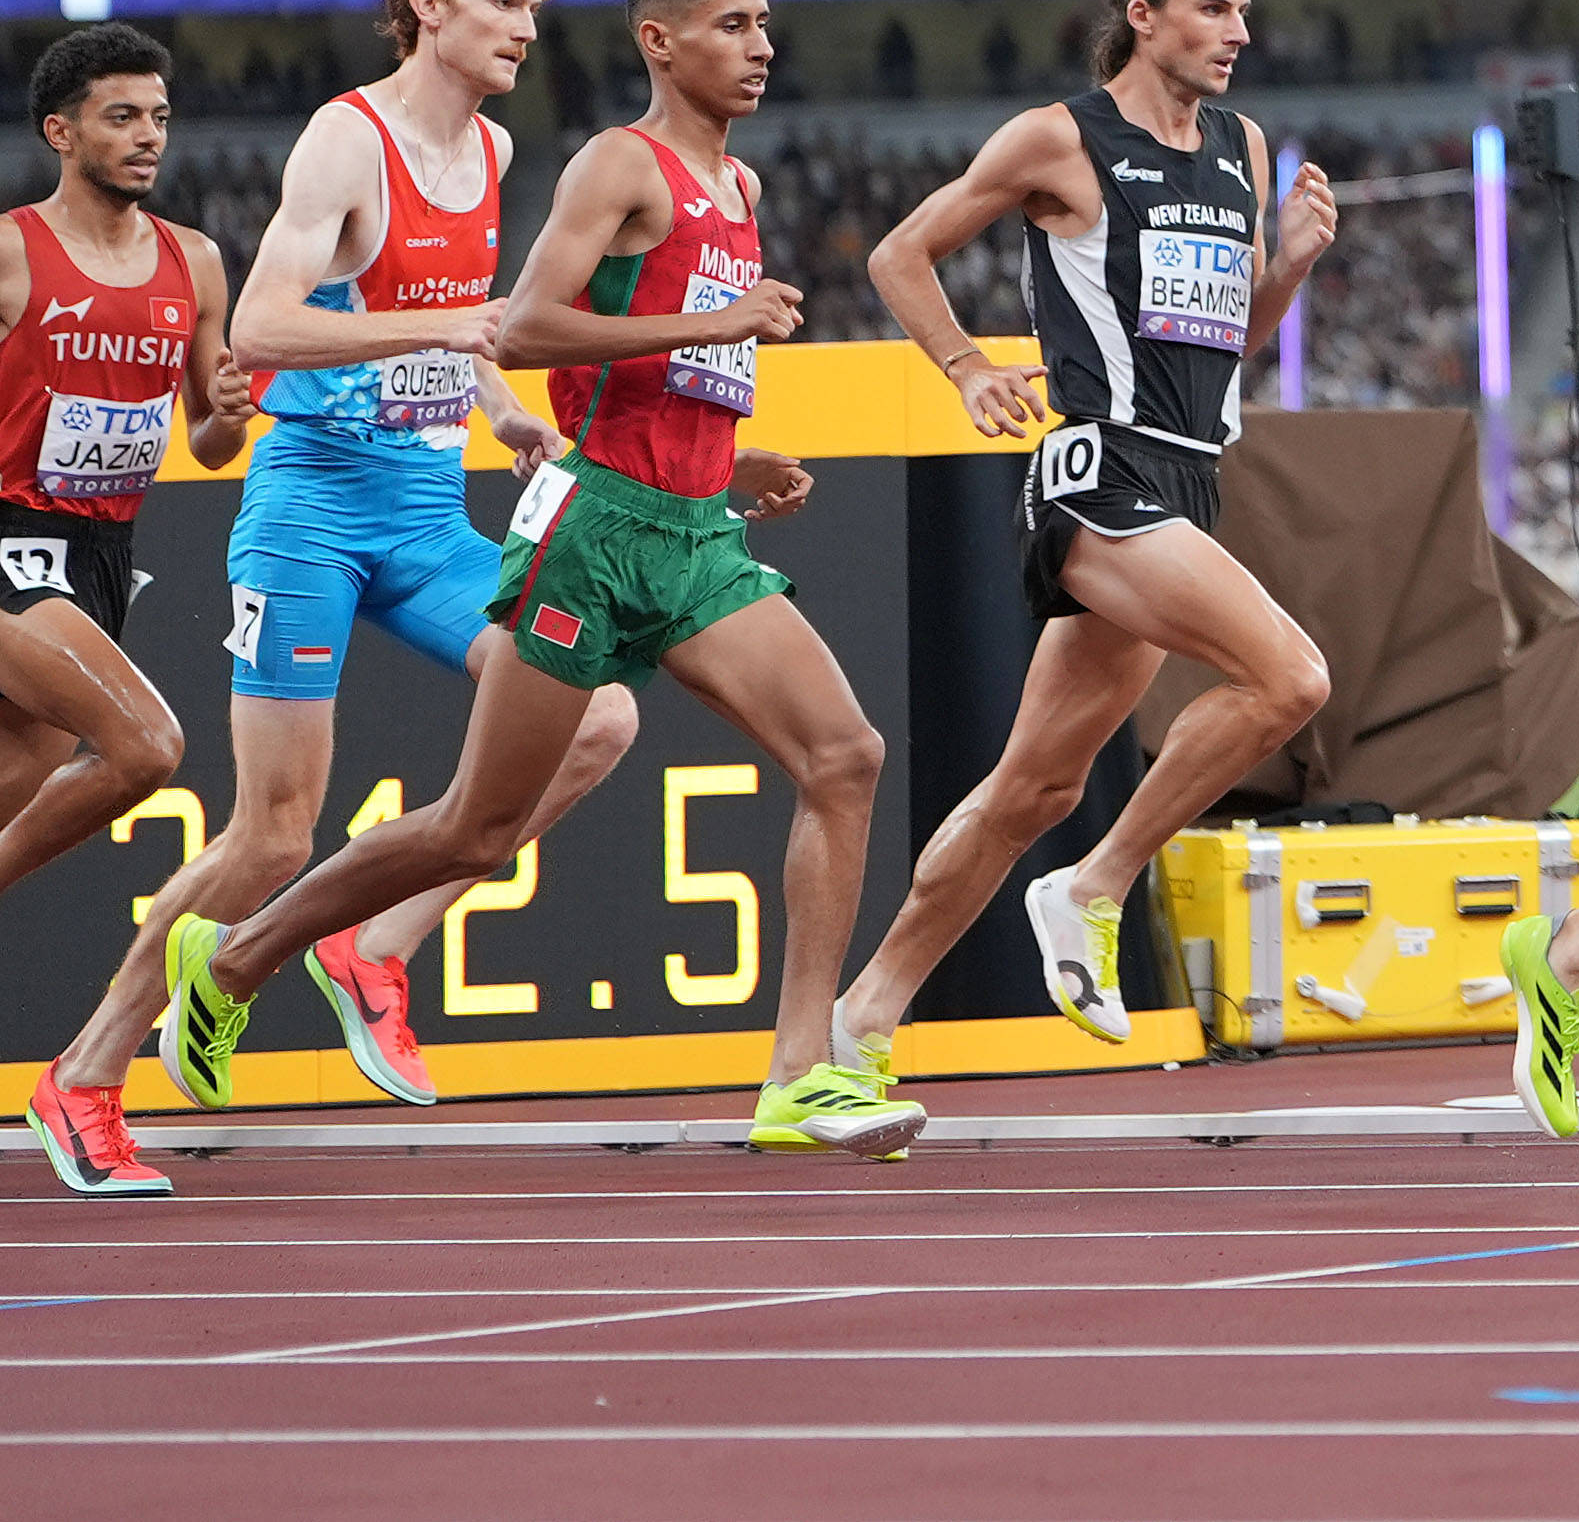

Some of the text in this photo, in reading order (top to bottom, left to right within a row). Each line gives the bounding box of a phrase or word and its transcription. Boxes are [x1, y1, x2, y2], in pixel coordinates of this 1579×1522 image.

[1148, 204, 1247, 233] NEW ZEALAND
[405, 237, 440, 248] CRAFT
[1183, 240, 1247, 279] TDK
[1151, 276, 1247, 321] BEAMISH
[49, 332, 184, 369] TUNISIA
[96, 401, 167, 435] TDK
[55, 437, 162, 471] JAZIRI
[1052, 437, 1094, 487] 10
[244, 601, 260, 649] 7
